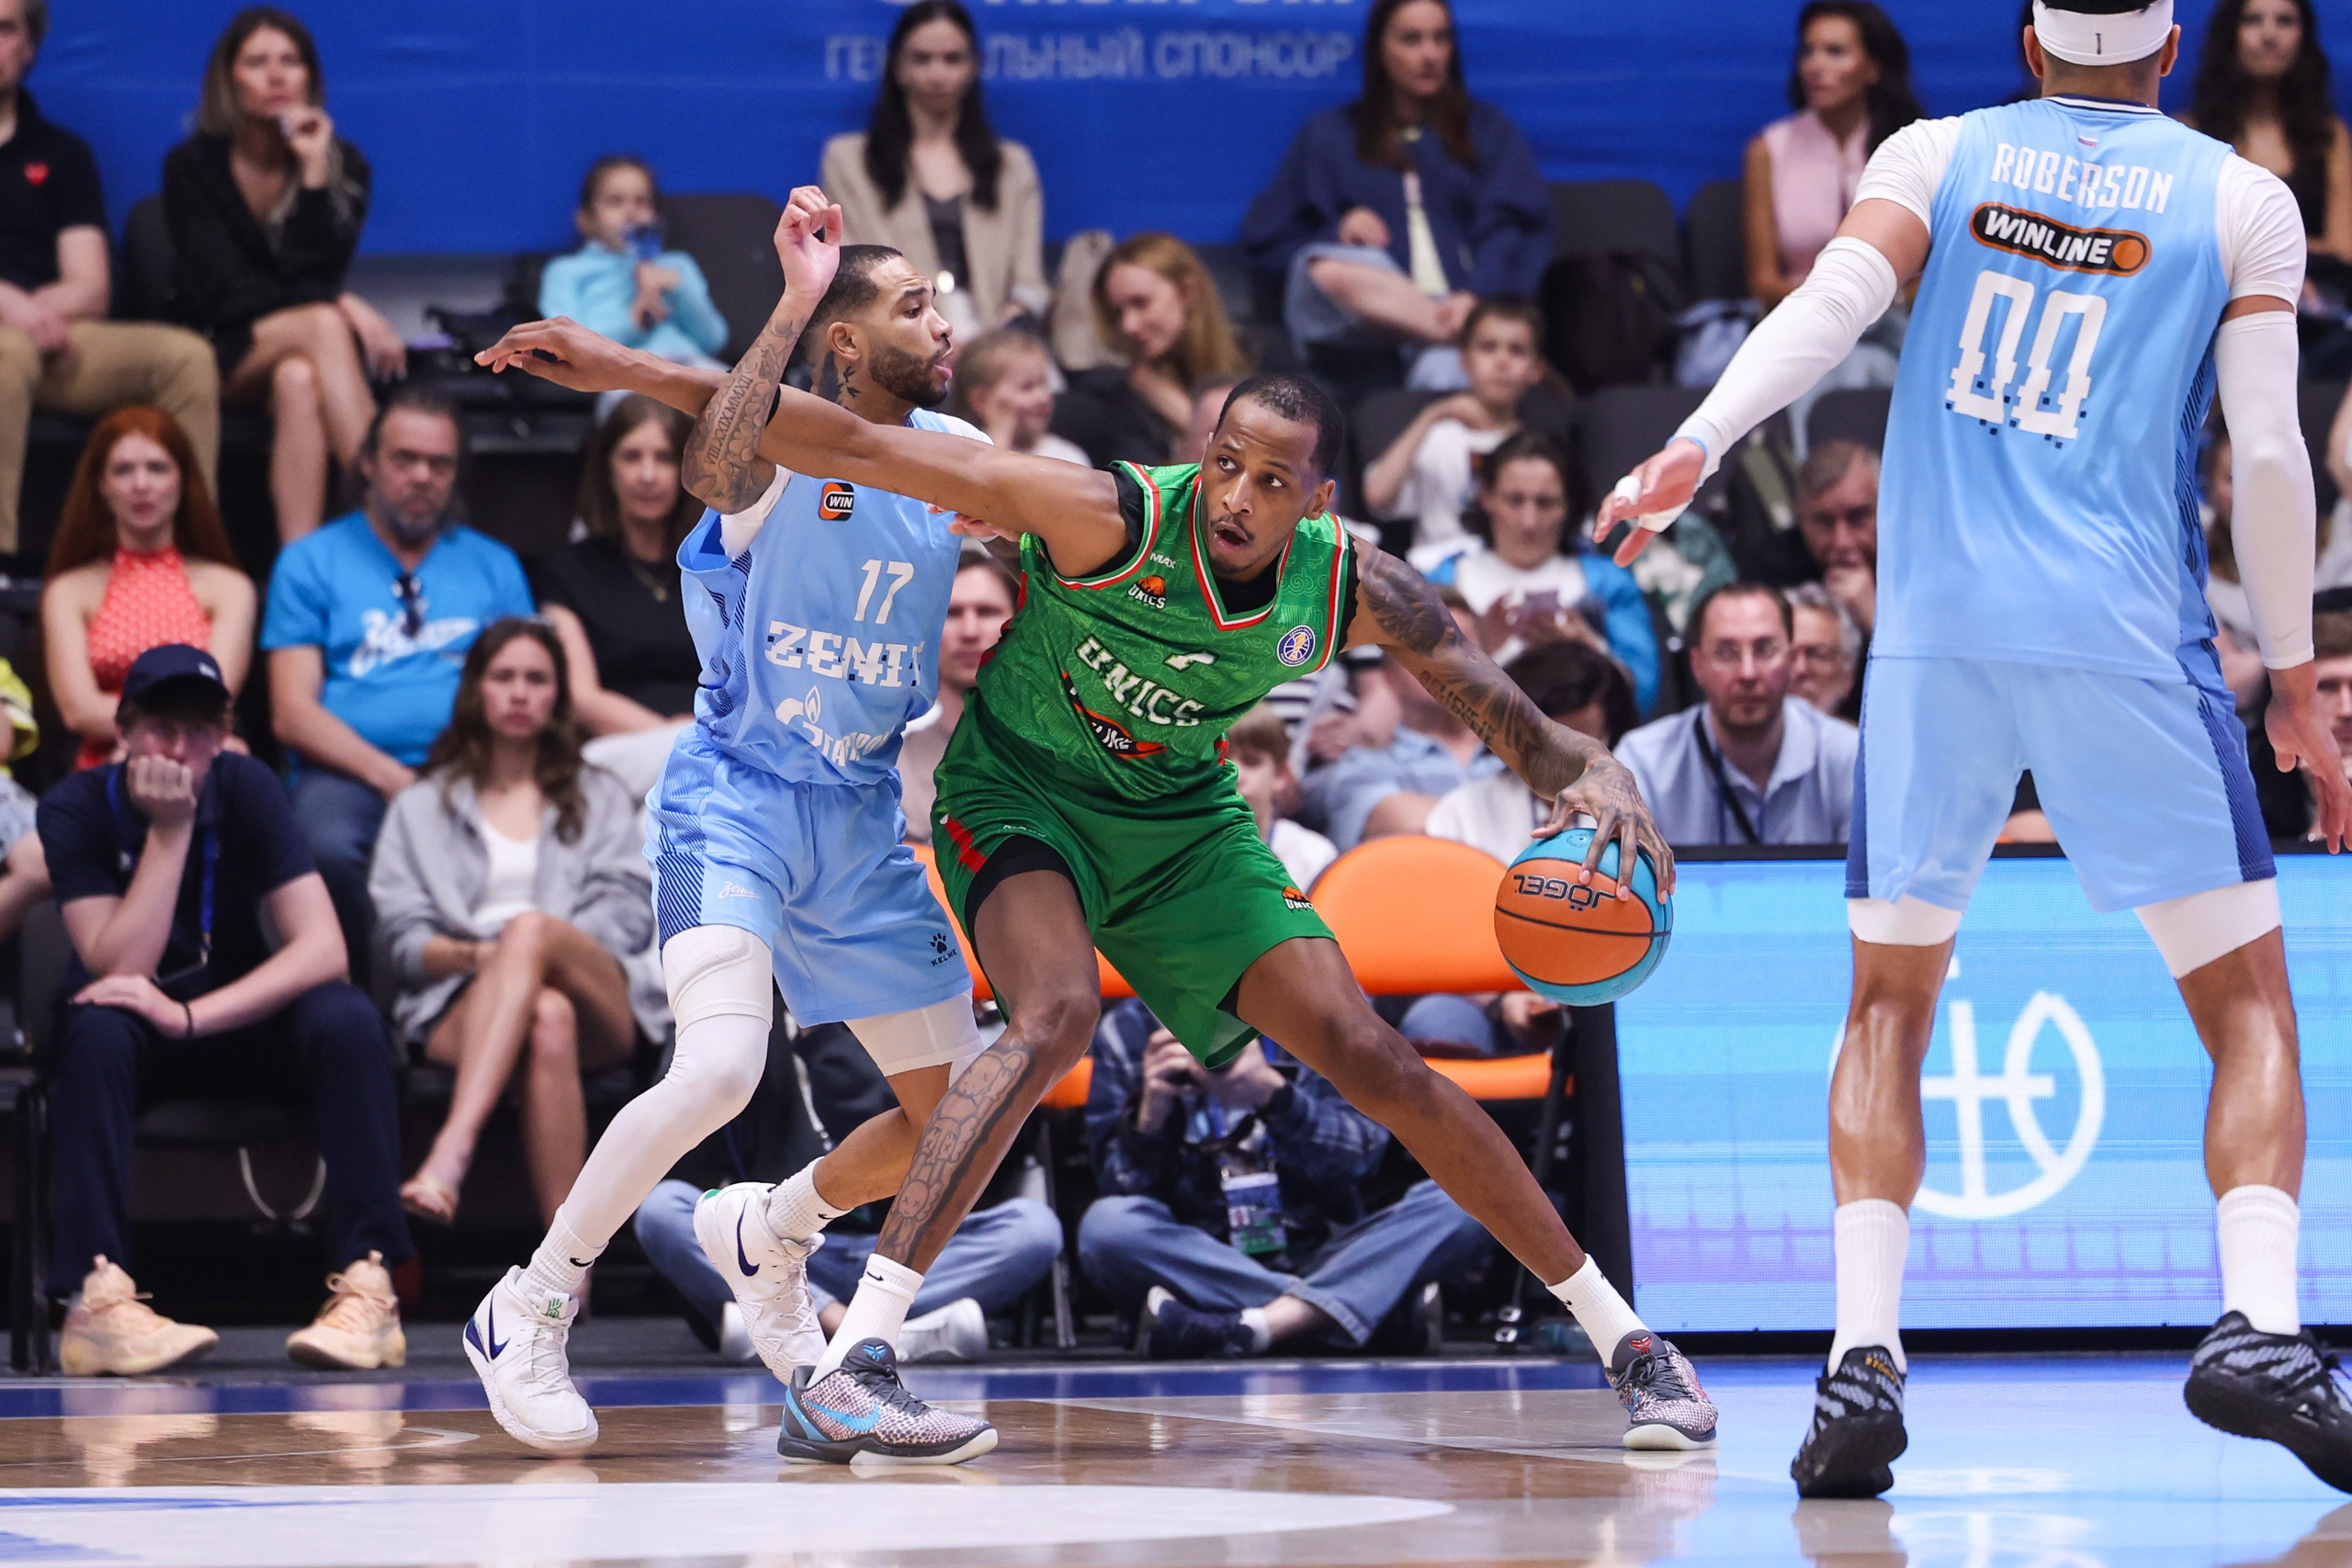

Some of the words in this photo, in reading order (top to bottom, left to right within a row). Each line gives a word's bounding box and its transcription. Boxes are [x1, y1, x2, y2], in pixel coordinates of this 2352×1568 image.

[826, 26, 1144, 81] ГЕЛЬНЫЙ
[1154, 32, 1355, 80] СПОНСОР
[1990, 142, 2175, 215] ROBERSON
[1984, 209, 2112, 265] WINLINE
[1946, 270, 2108, 441] 00
[829, 494, 854, 509] WIN
[854, 559, 915, 625] 17
[1127, 582, 1167, 609] UNICS
[1076, 634, 1207, 727] UNICS
[1283, 897, 1314, 910] UNIC
[1513, 874, 1616, 912] JÖGEL
[931, 948, 957, 967] KELME
